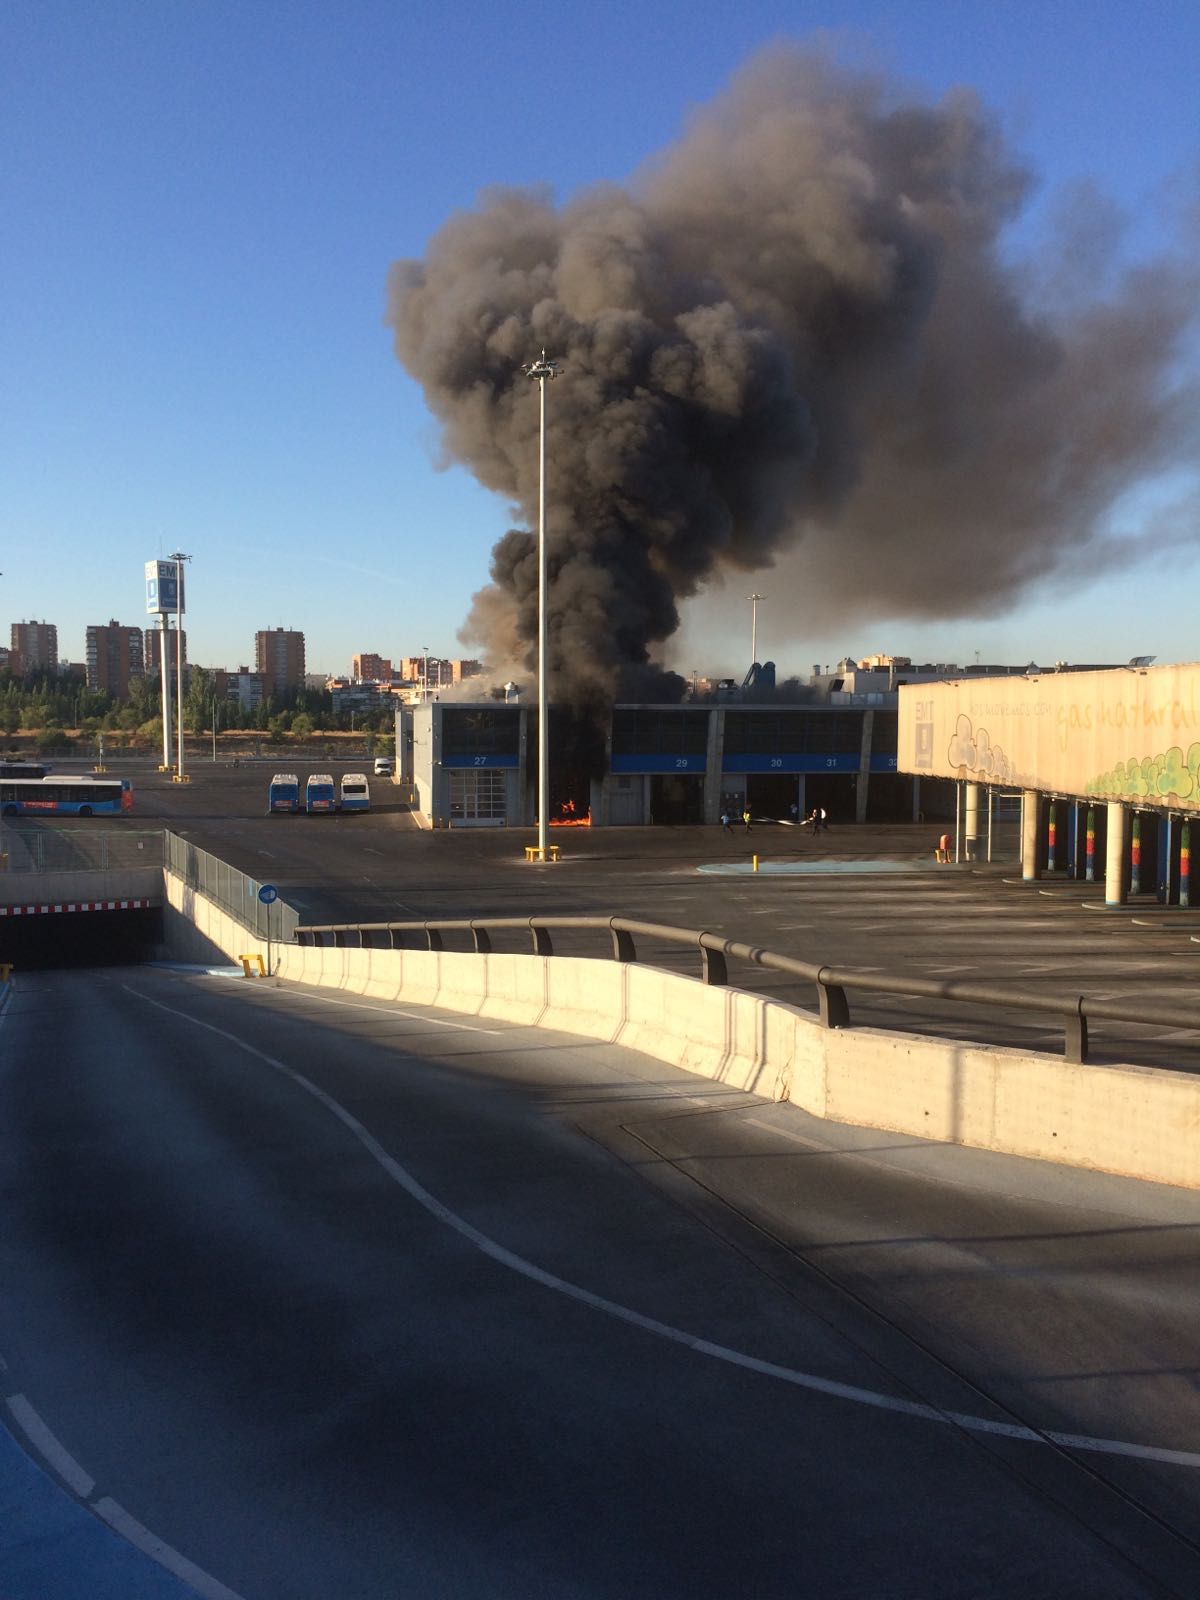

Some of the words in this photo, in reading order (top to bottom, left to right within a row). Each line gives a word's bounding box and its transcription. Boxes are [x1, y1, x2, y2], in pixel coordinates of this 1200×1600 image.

[915, 700, 934, 720] EMT
[474, 756, 487, 765] 27
[676, 758, 688, 768] 29
[770, 758, 783, 768] 30
[826, 758, 837, 767] 31
